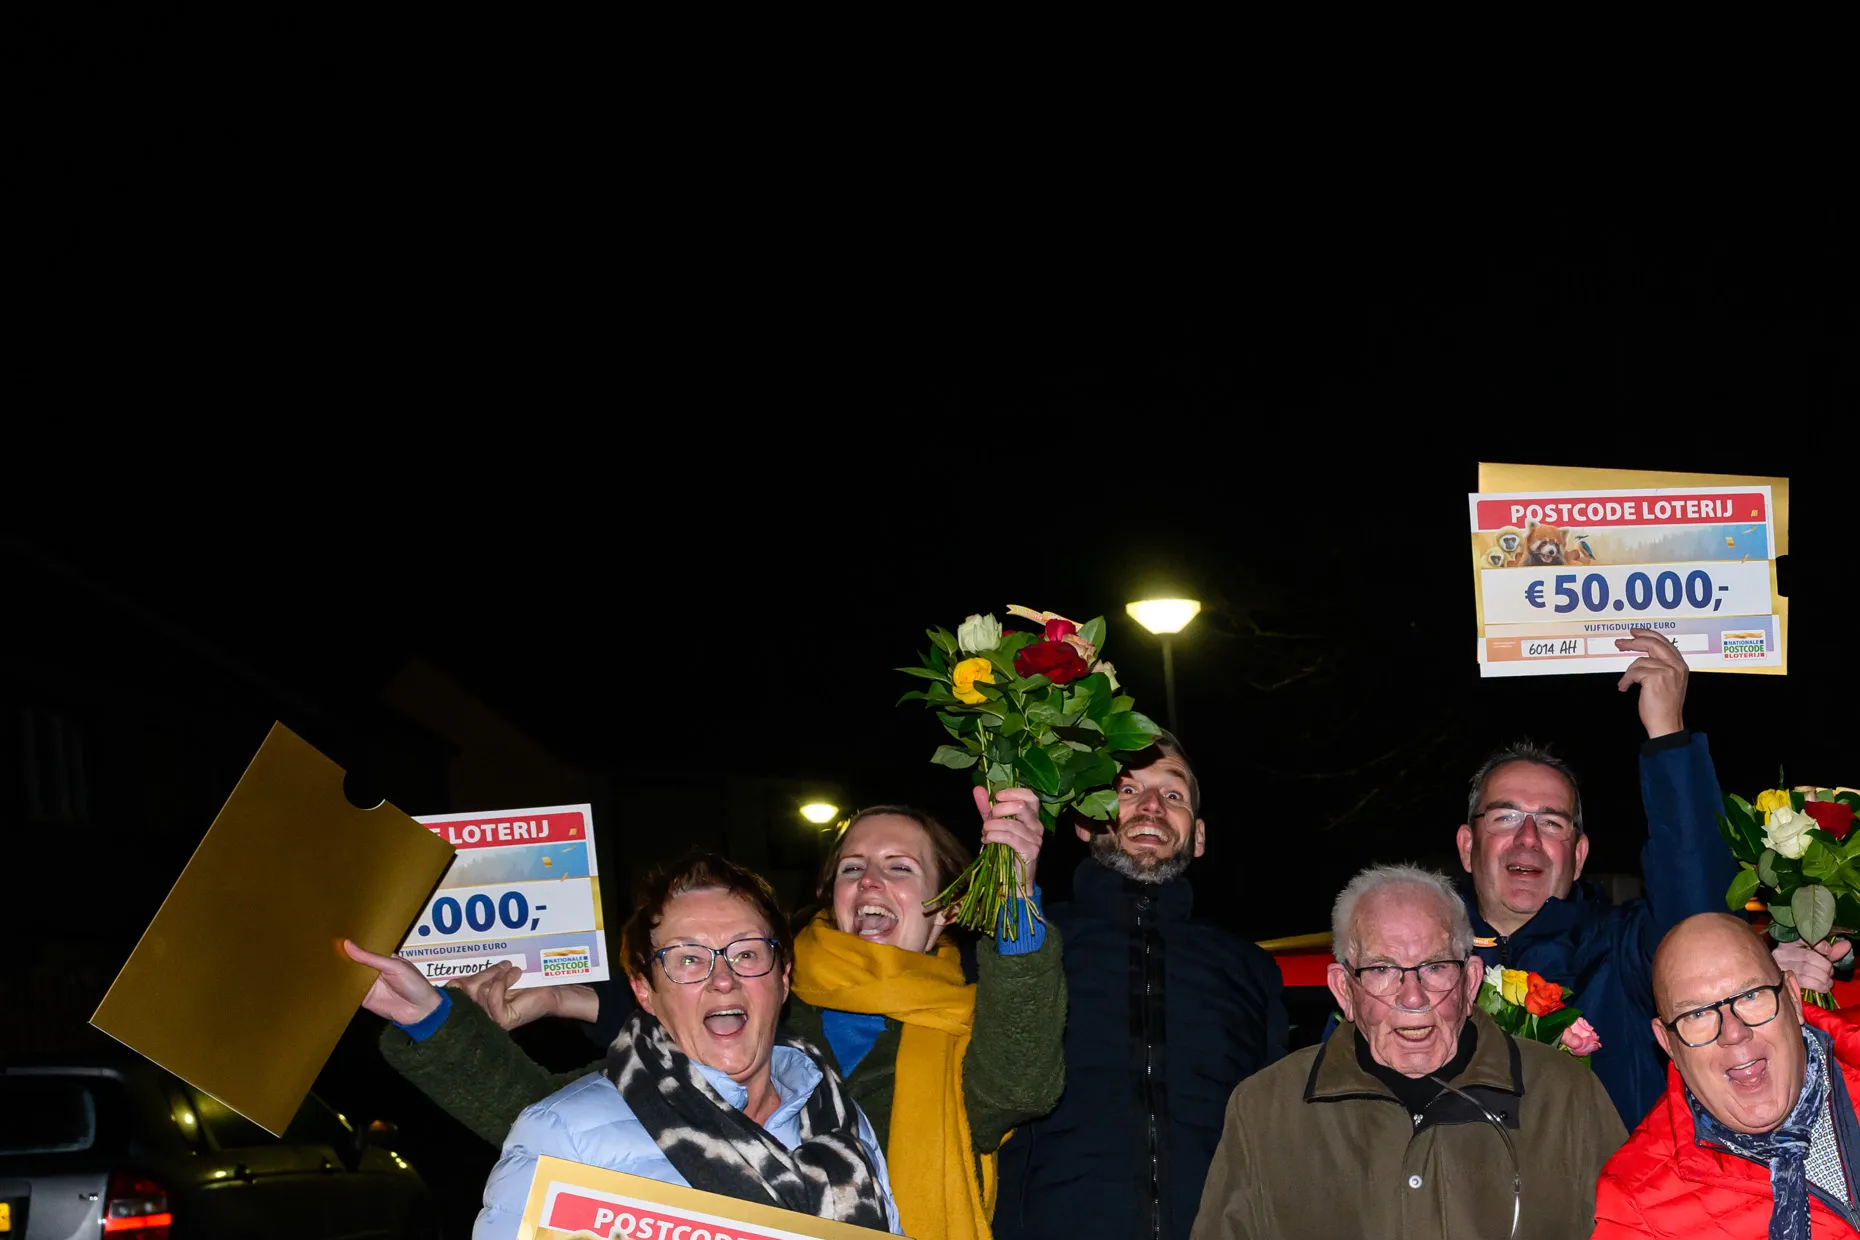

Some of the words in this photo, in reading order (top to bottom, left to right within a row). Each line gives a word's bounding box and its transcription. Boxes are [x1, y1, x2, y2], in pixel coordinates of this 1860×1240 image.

[1511, 502, 1636, 524] POSTCODE
[1642, 500, 1733, 519] LOTERIJ
[1584, 622, 1651, 632] VIJFTIGDUIZEND
[1654, 621, 1676, 630] EURO
[1529, 642, 1554, 656] 6014
[1560, 639, 1577, 655] AH
[1724, 645, 1764, 654] POSTCODE
[449, 820, 549, 844] LOTERIJ
[418, 891, 547, 937] .000,-
[400, 945, 481, 959] TWINTIGDUIZEND
[482, 942, 507, 952] EURO
[543, 961, 589, 972] POSTCODE
